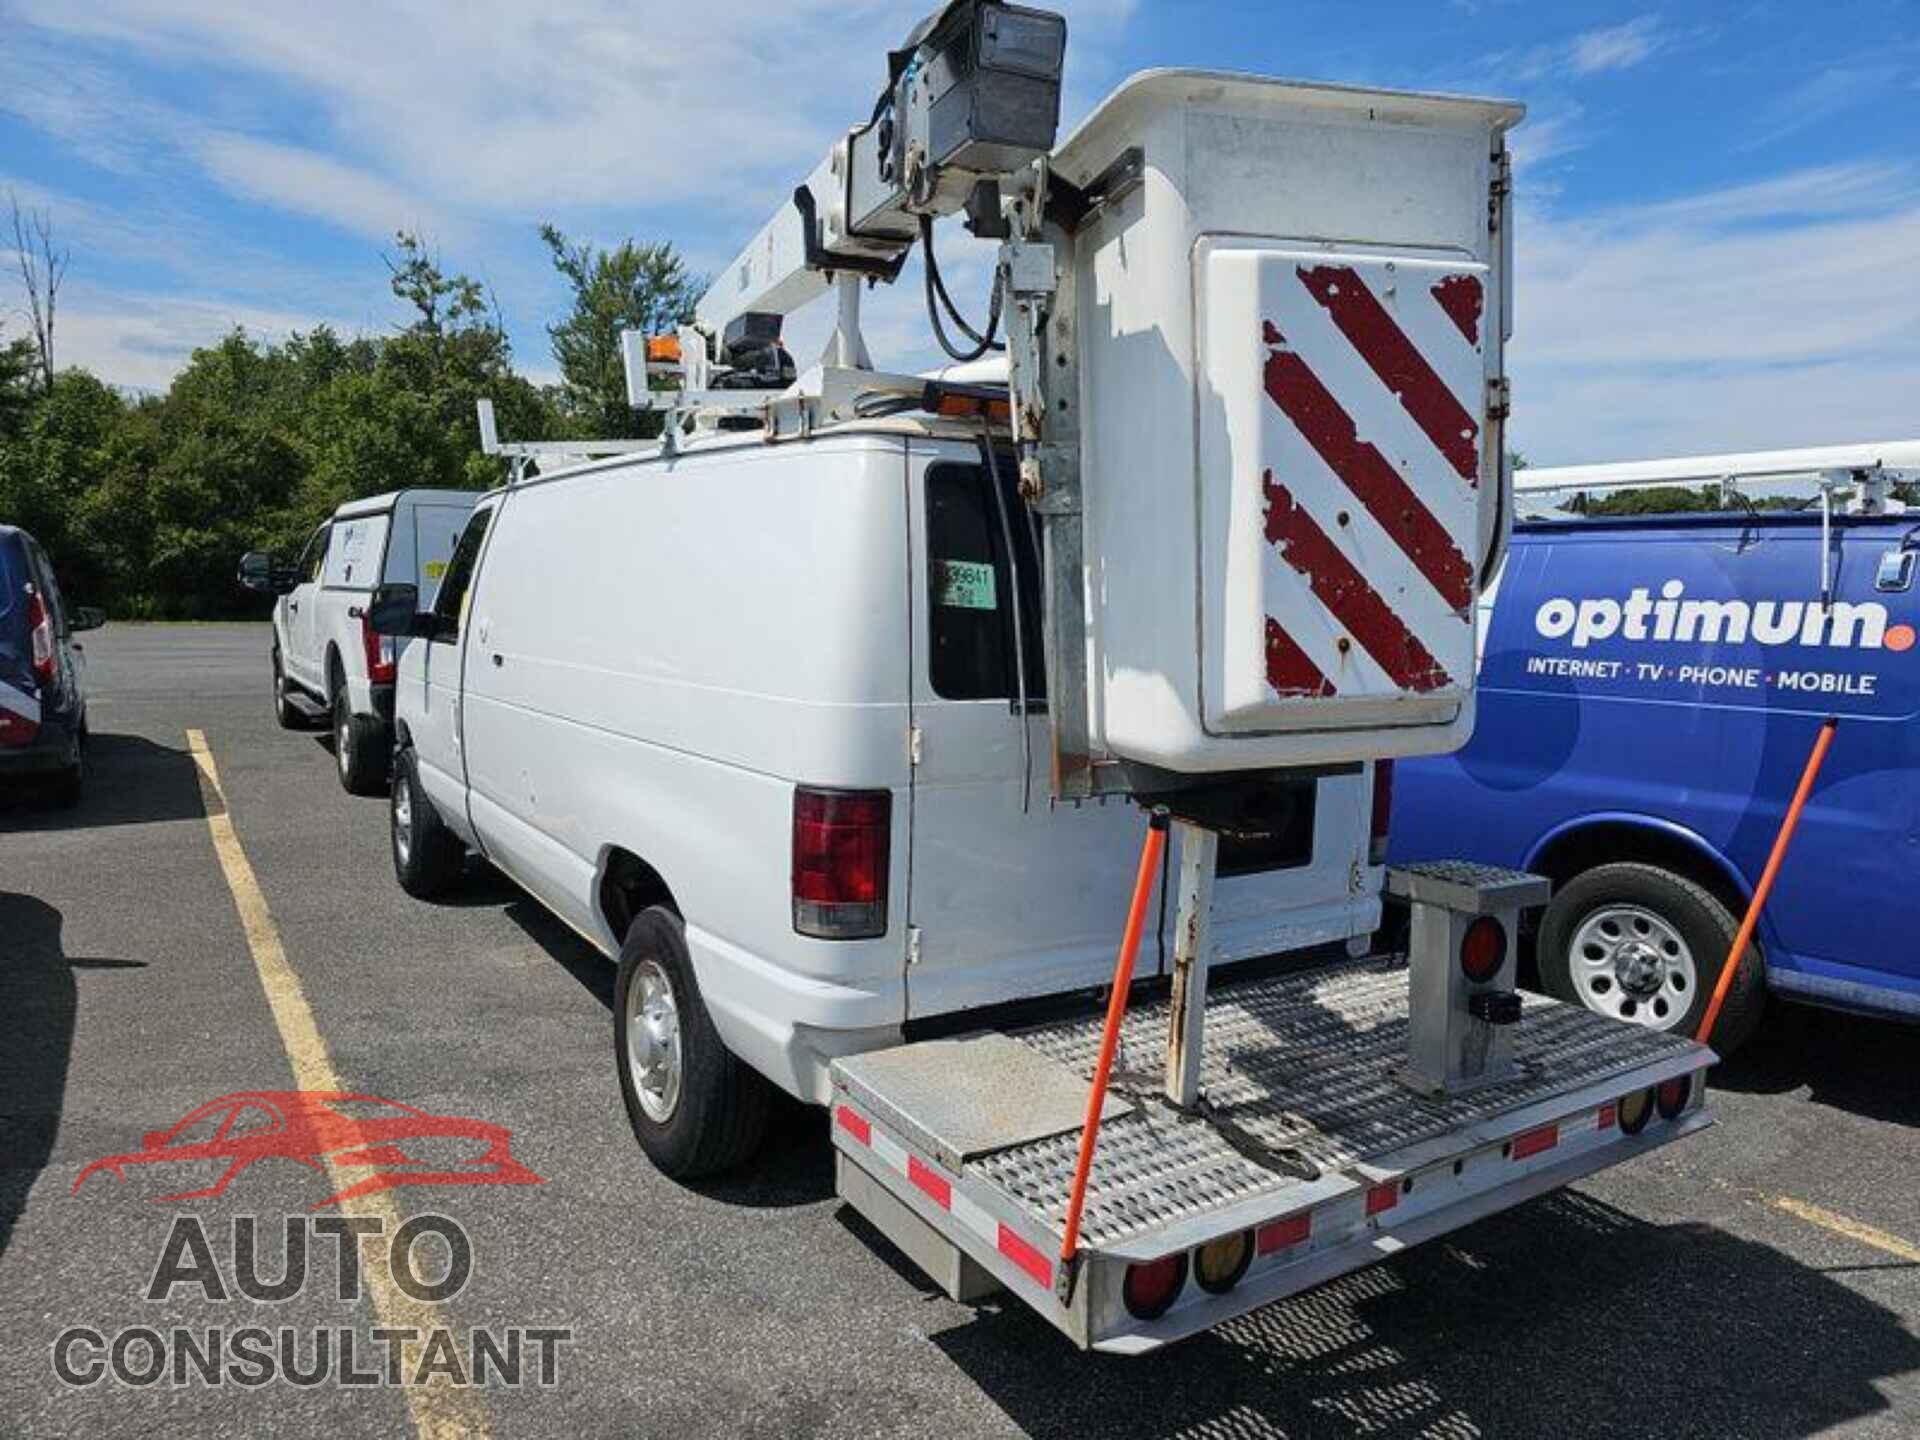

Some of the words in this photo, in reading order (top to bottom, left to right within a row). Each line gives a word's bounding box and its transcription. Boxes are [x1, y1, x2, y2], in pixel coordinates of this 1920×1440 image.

[1526, 657, 1622, 678] INTERNET
[1637, 664, 1664, 681] TV
[1679, 667, 1760, 688] PHONE
[1777, 671, 1878, 695] MOBILE
